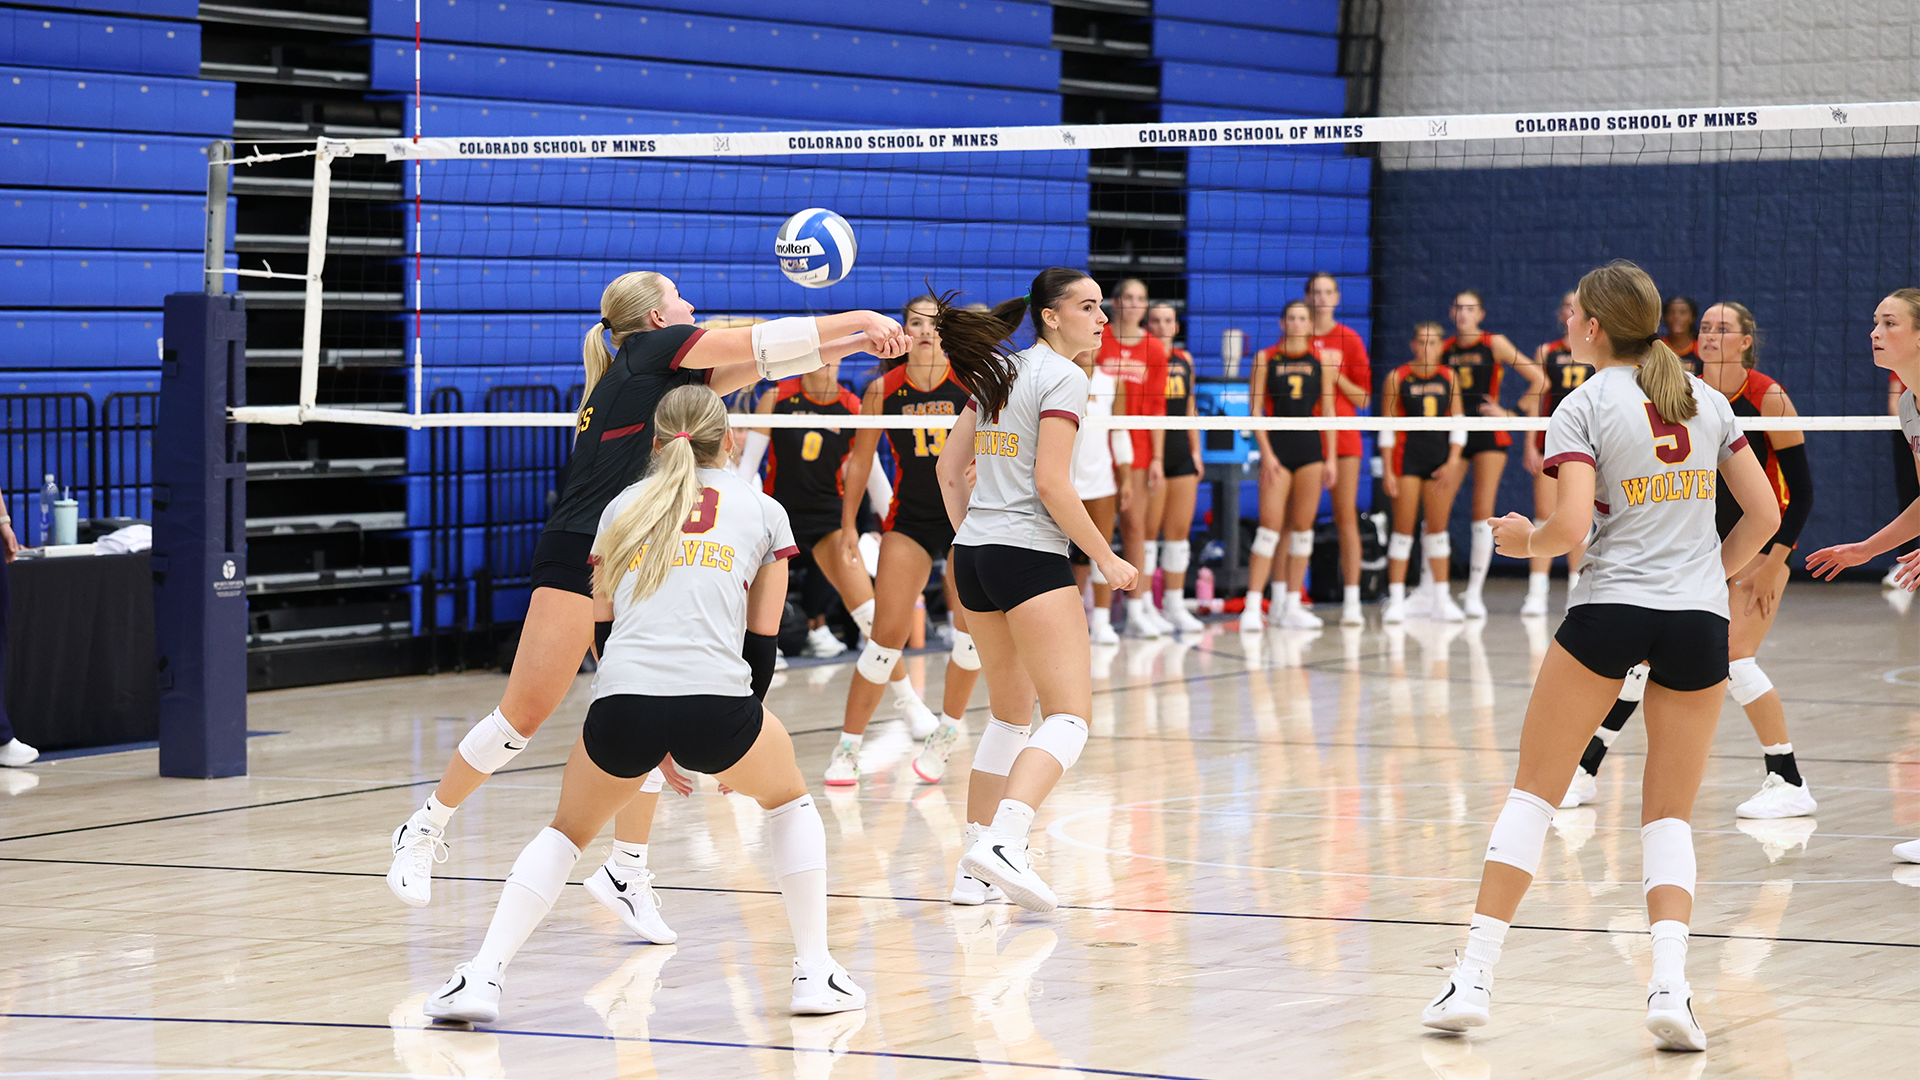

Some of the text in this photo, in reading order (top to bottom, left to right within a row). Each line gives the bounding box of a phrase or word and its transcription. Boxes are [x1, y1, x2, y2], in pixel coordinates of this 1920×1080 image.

[1428, 119, 1448, 137] M
[1515, 111, 1758, 133] COLORADO SCHOOL OF MINES
[713, 135, 731, 152] M
[788, 133, 999, 150] COLORADO SCHOOL OF MINES
[1138, 124, 1363, 143] COLORADO SCHOOL OF MINES
[459, 140, 656, 155] COLORADO SCHOOL OF MINES
[1287, 374, 1303, 400] 7
[912, 428, 948, 457] 13
[1642, 400, 1693, 466] 5
[801, 430, 824, 462] 0
[1621, 469, 1715, 507] WOLVES
